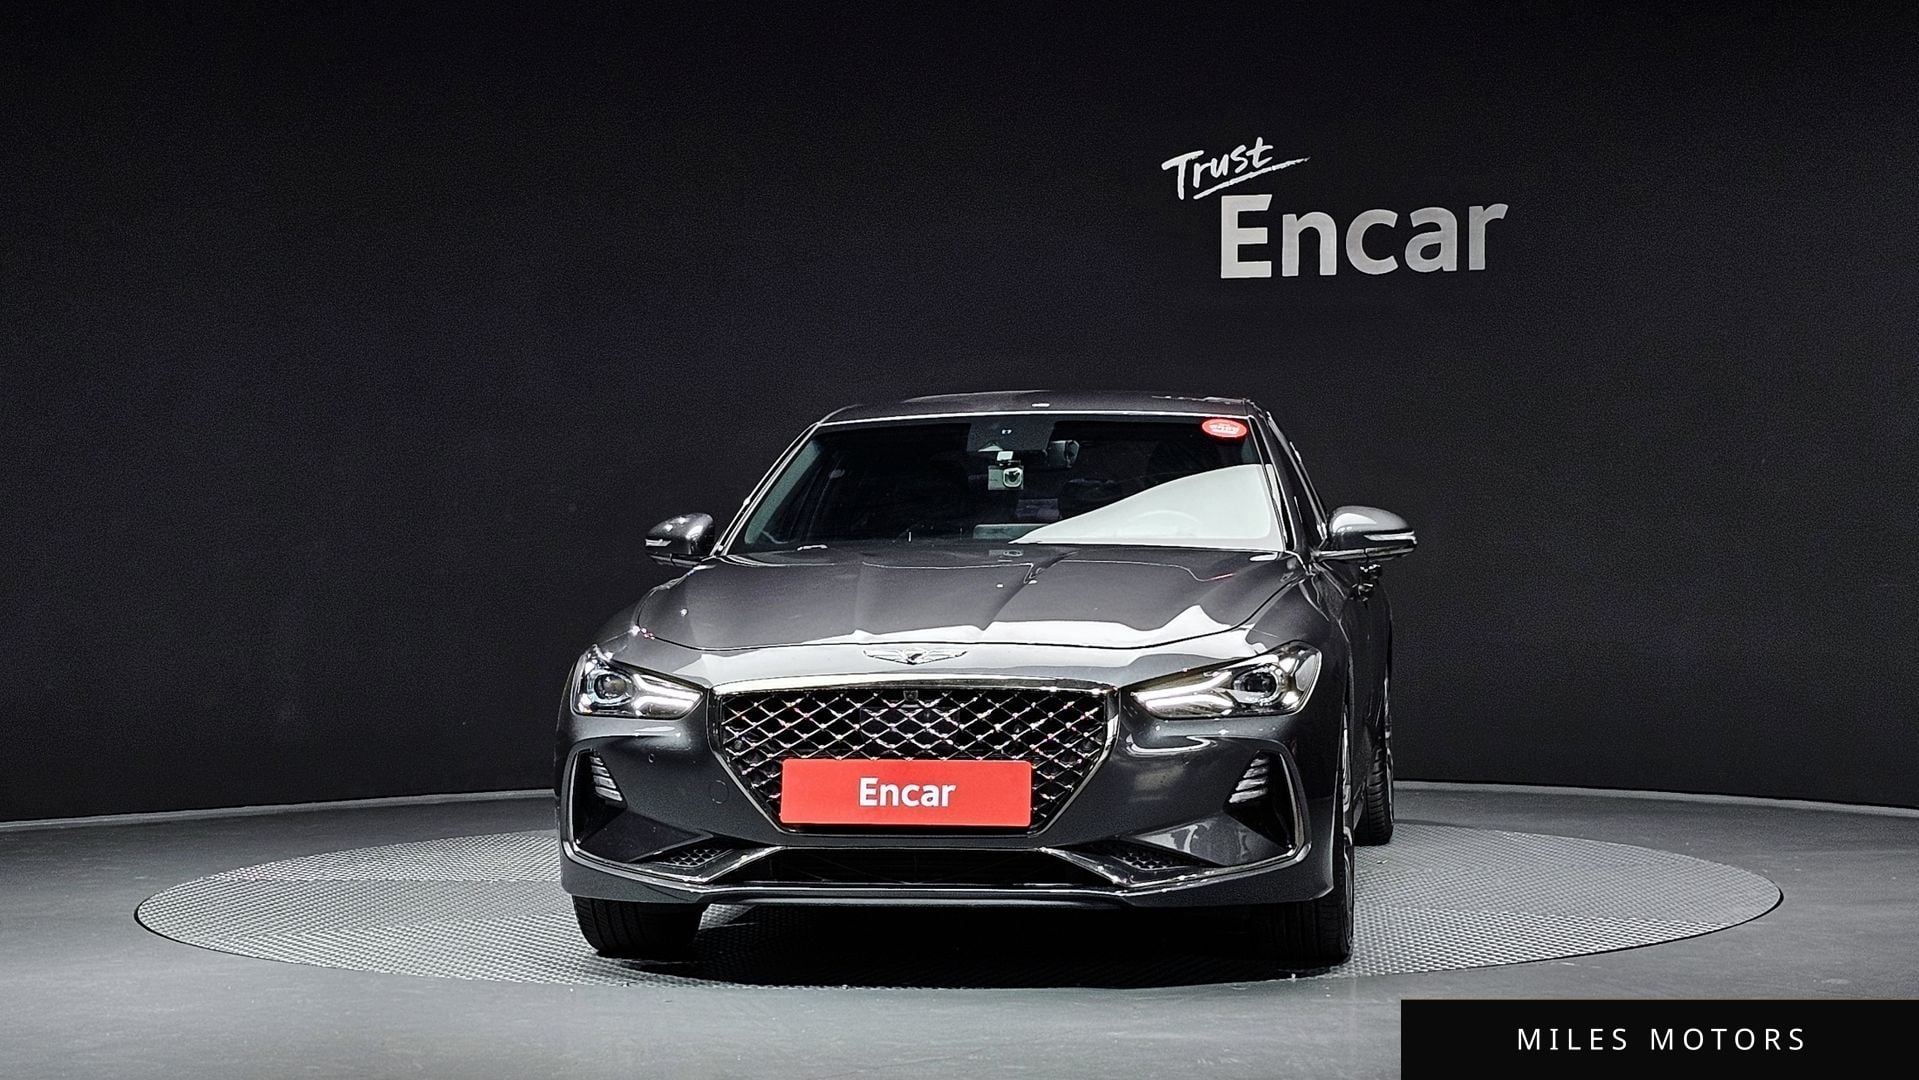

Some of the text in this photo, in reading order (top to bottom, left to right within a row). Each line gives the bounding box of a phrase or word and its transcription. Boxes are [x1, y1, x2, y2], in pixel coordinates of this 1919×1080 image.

[1161, 136, 1274, 200] Trust
[1220, 193, 1509, 279] Encar
[858, 777, 957, 808] Encar
